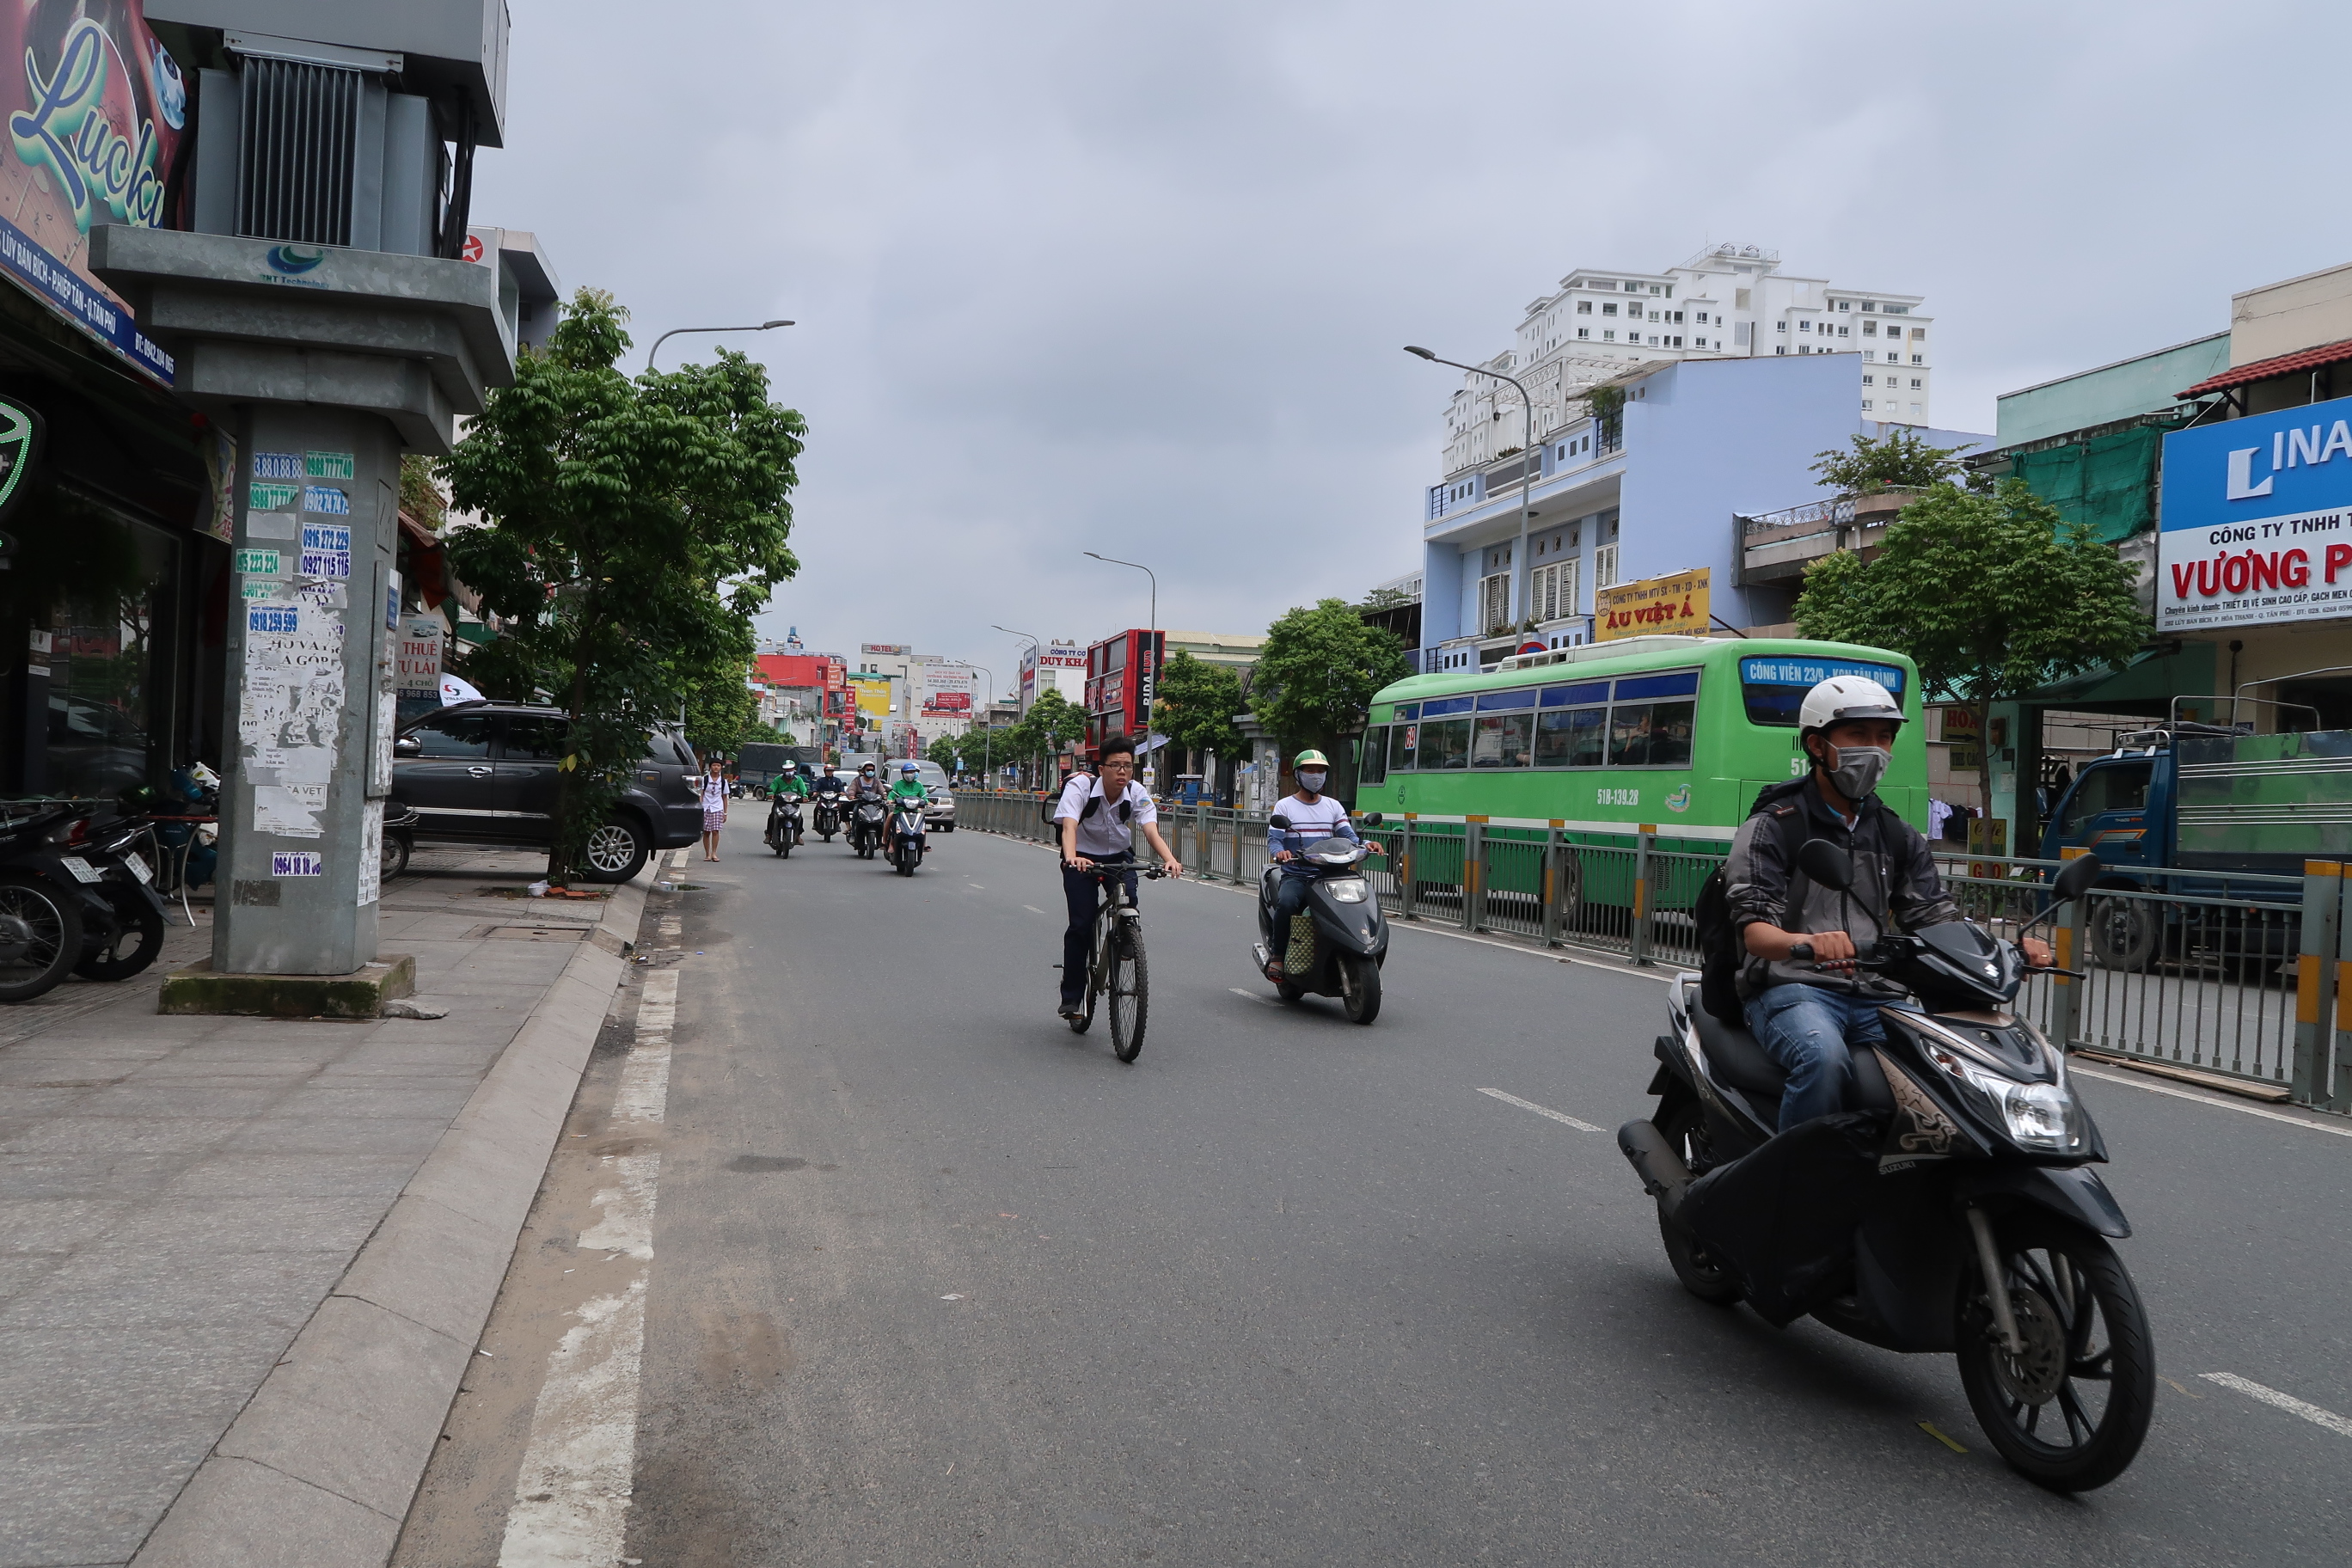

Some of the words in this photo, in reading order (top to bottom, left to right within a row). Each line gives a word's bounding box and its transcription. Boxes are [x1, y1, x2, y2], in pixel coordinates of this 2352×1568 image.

[2209, 525, 2256, 545] CÔNG
[2261, 523, 2285, 539] TY
[2290, 514, 2340, 535] TNHH
[303, 555, 349, 576] 0927.115.116
[2171, 548, 2310, 598] VƯƠNG
[1613, 593, 1626, 604] CÔNG
[1627, 593, 1633, 603] TY
[1634, 590, 1648, 601] TNHH
[1649, 587, 1660, 598] MTV
[1661, 586, 1668, 596] SX
[1672, 584, 1681, 593] TM
[1685, 581, 1692, 591] XD
[1697, 579, 1708, 590] XNK
[1634, 601, 1676, 624] VIỆT
[1680, 594, 1694, 617] Á
[2165, 606, 2185, 615] Chuyên
[2187, 604, 2200, 613] kinh
[2222, 597, 2241, 609] THIẾT
[2243, 599, 2250, 609] BỊ
[2251, 596, 2259, 609] VỆ
[2262, 597, 2277, 606] SINH
[2279, 595, 2292, 604] CAO
[2311, 591, 2330, 603] GẠCH
[2332, 590, 2348, 599] MEN
[250, 612, 297, 632] 0918.259.599
[402, 640, 438, 656] THUÊ
[414, 658, 436, 675] LÁI
[1040, 656, 1063, 666] DUY
[407, 679, 413, 688] 4
[1749, 661, 1777, 680] CÔNG
[1779, 662, 1802, 682] VIÊN
[1804, 666, 1824, 683] 23/9
[1873, 668, 1896, 688] BÌNH
[406, 689, 421, 698] 968
[423, 690, 438, 699] 853
[1406, 726, 1416, 748] 69
[1597, 788, 1638, 805] 51B-139.28
[1878, 1161, 1916, 1175] SUZUKI
